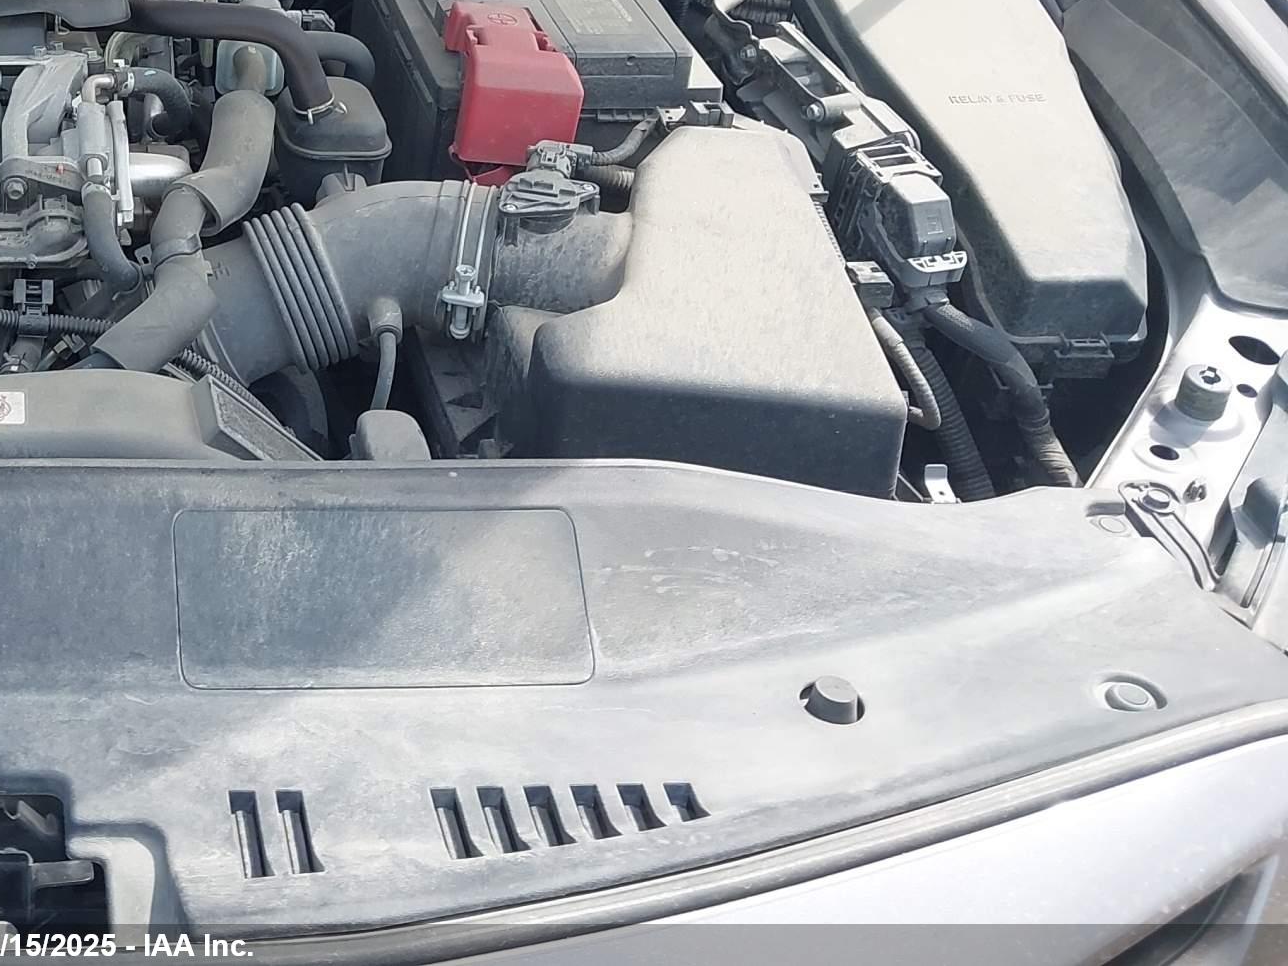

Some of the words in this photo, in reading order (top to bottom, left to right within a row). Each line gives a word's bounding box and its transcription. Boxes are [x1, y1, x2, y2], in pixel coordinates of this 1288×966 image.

[948, 94, 993, 105] RELAY
[996, 95, 1005, 104] &
[1009, 93, 1046, 104] FUSE
